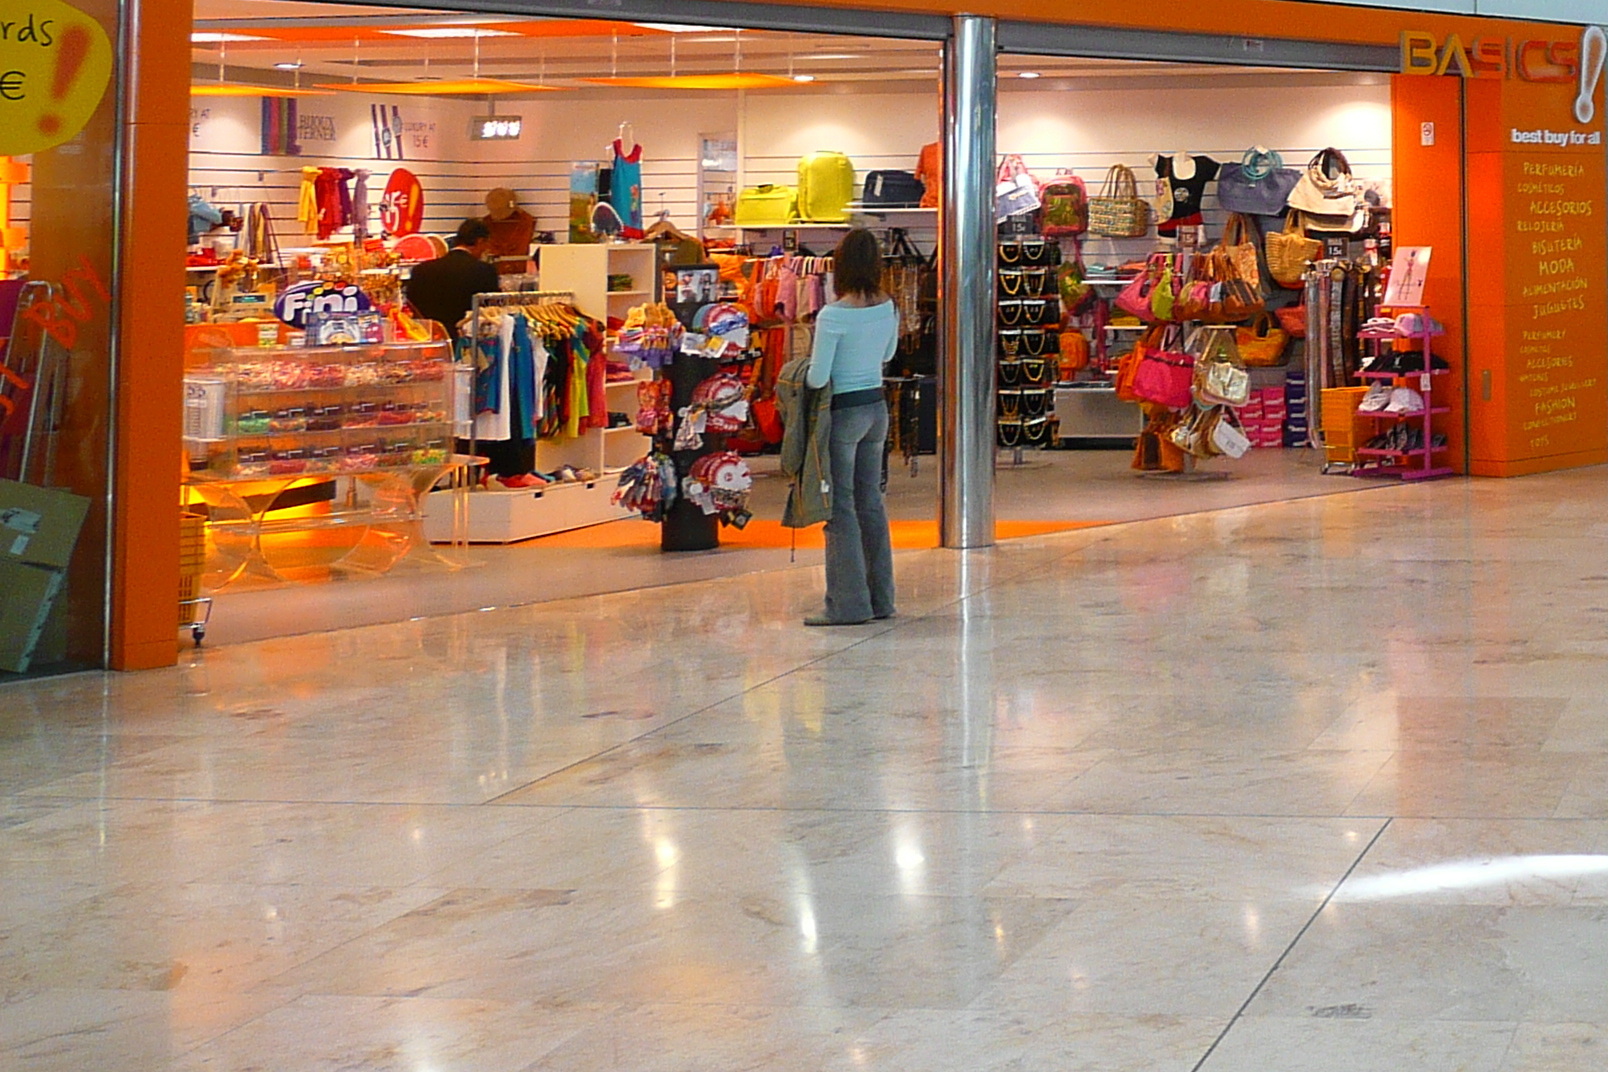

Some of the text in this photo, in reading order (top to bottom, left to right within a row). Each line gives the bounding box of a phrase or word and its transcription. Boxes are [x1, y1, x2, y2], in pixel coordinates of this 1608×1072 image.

[1, 14, 54, 46] rds
[1512, 128, 1601, 147] best buy for all
[1523, 162, 1584, 177] PERFUMERÍA
[1530, 200, 1592, 216] ACCESORIOS
[1532, 232, 1582, 255] BISUTERÍA
[1539, 258, 1575, 275] MODA
[1523, 276, 1588, 297] ALIMENTACIÓN
[283, 286, 358, 325] Fini
[1532, 294, 1585, 319] JUGUETES
[1535, 396, 1575, 415] FASHION
